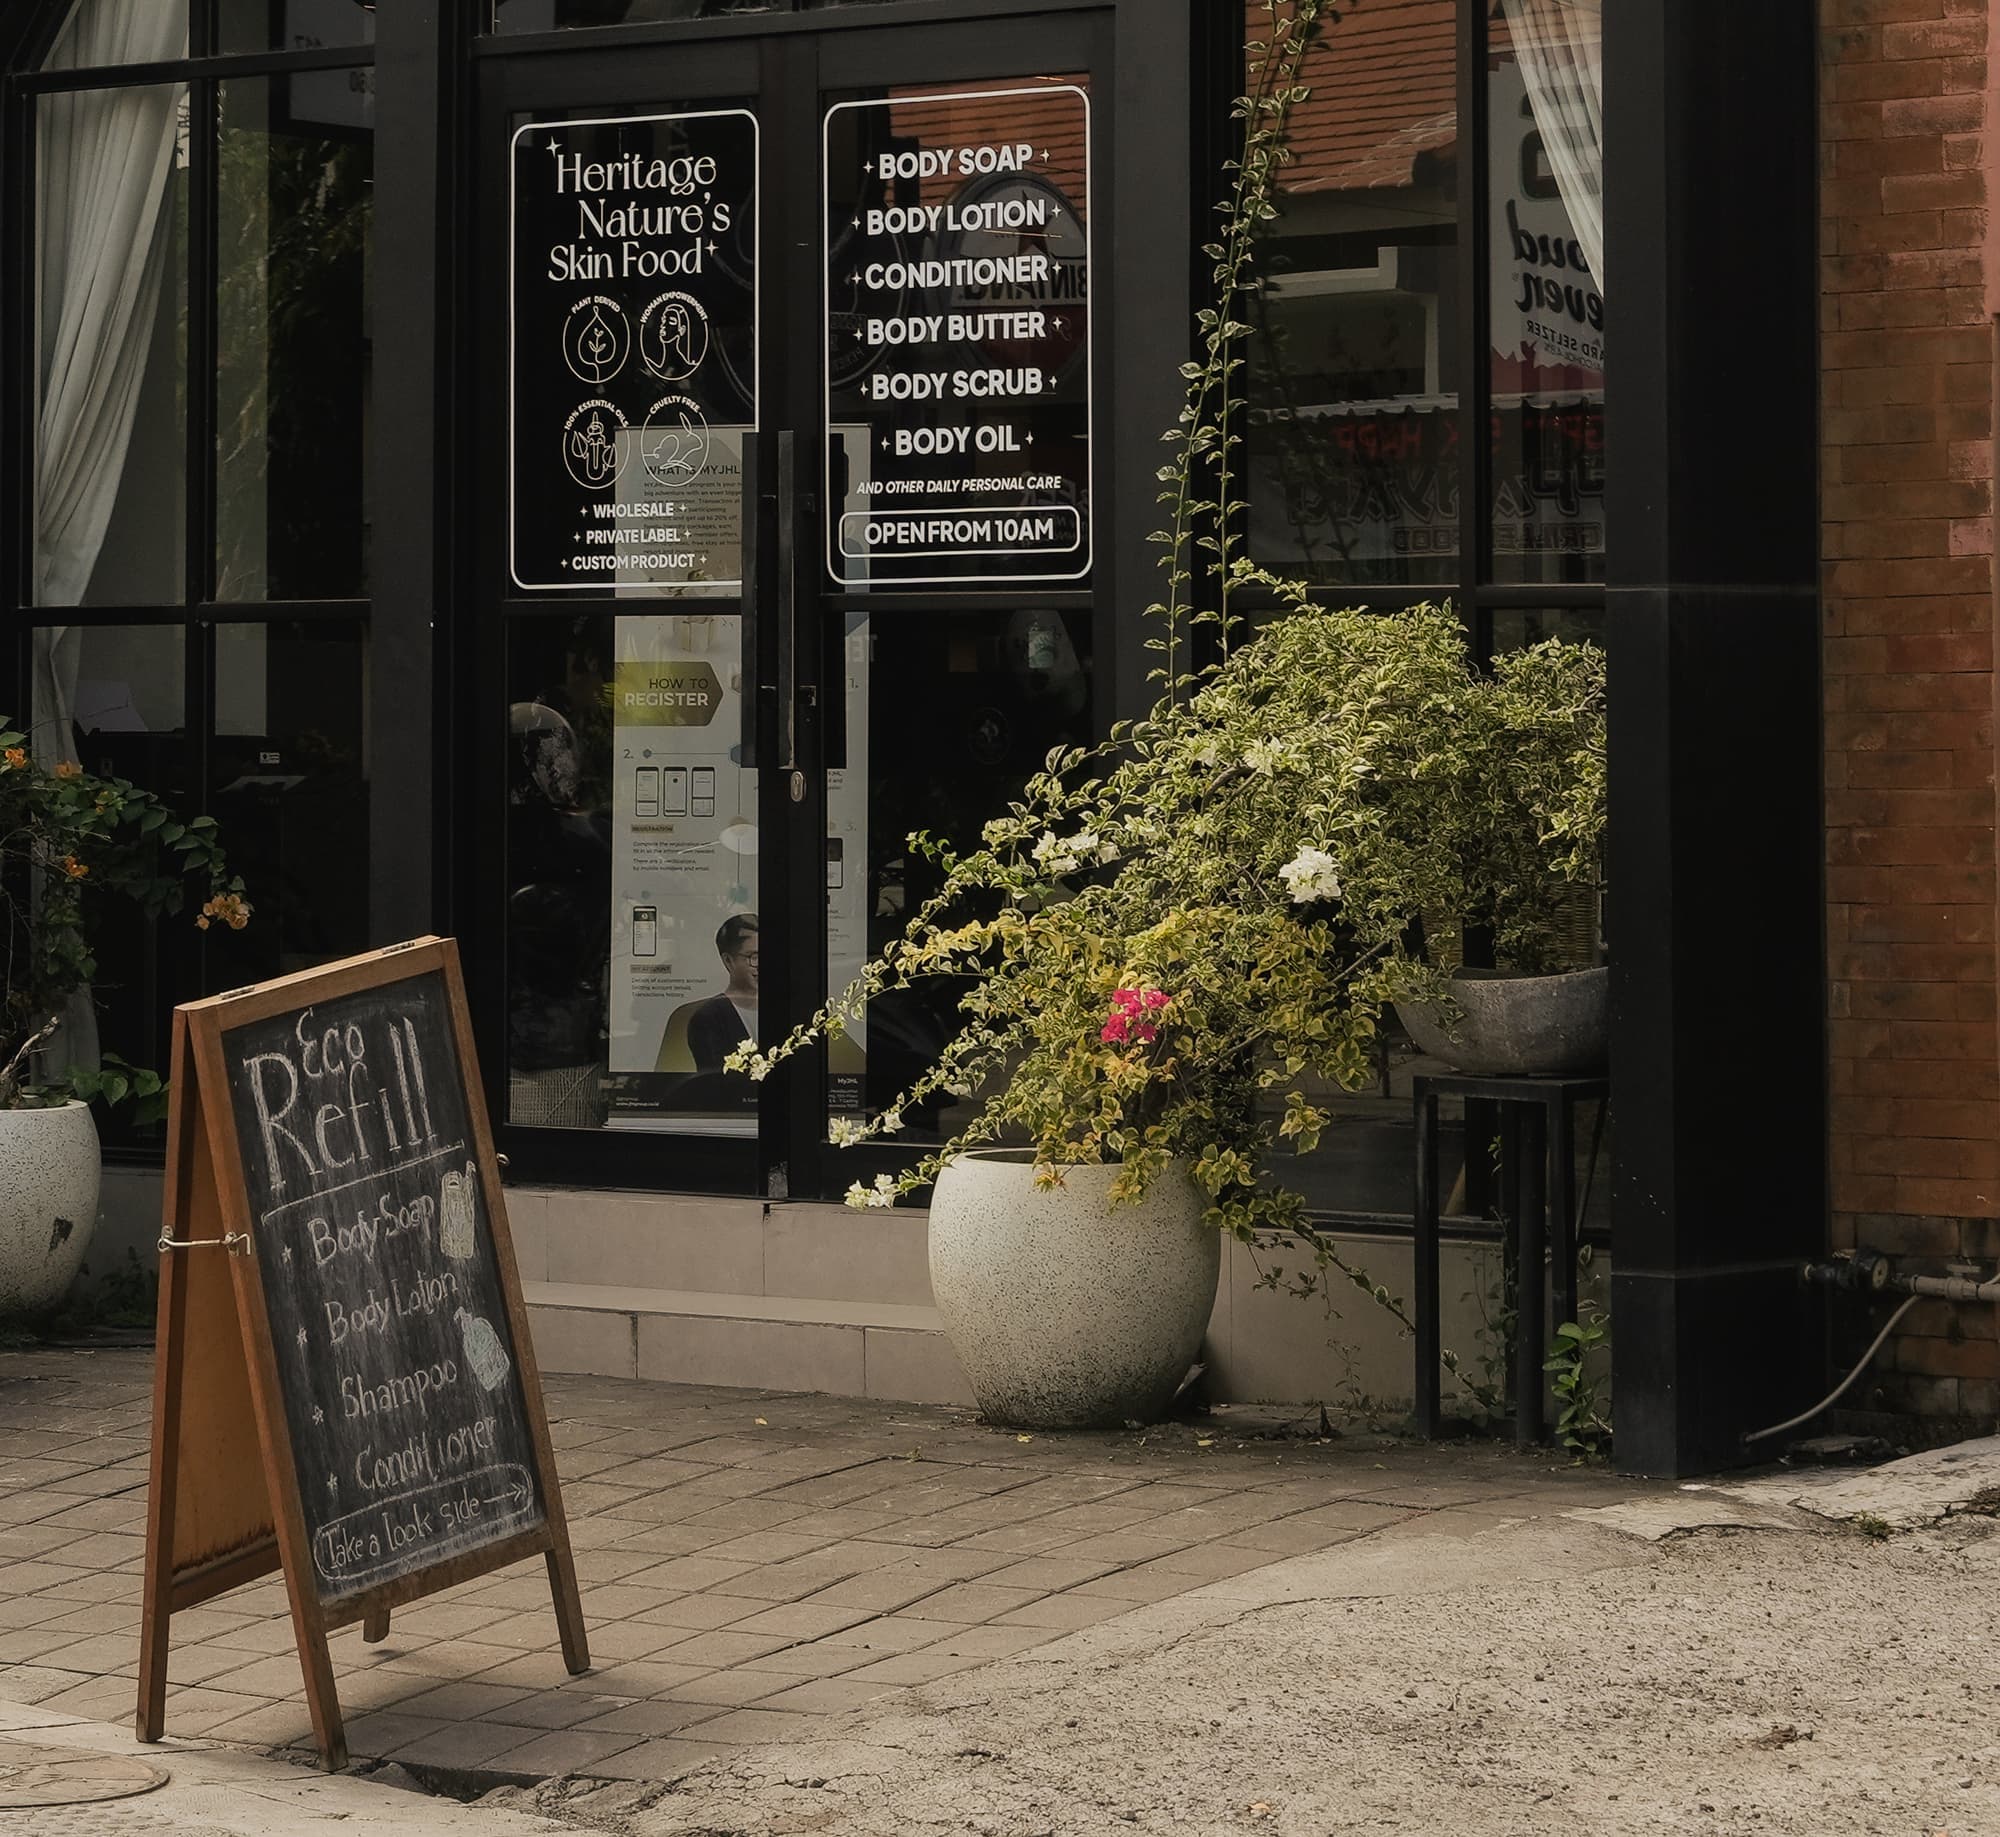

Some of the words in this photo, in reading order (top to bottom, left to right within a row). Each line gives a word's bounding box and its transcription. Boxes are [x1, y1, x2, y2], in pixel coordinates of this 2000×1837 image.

[557, 152, 716, 195] Heritage
[879, 149, 954, 179] BODY
[958, 144, 1033, 175] SOAP
[578, 192, 731, 239] Nature's
[867, 206, 942, 235] BODY
[947, 200, 1045, 231] LOTION
[548, 244, 613, 281] Skin
[622, 237, 702, 277] Food
[865, 255, 1048, 290] CONDITIONER
[571, 297, 591, 314] PLANT
[594, 295, 621, 312] DERIVED
[640, 296, 663, 323] WOMAN
[867, 316, 943, 345] BODY
[948, 311, 1046, 341] BUTTER
[872, 373, 948, 400] BODY
[952, 368, 1043, 398] SCRUB
[564, 410, 579, 430] 100%
[578, 399, 616, 413] ESSENTIAL
[615, 409, 629, 428] OILS
[649, 395, 681, 415] CRUELTY
[682, 396, 701, 413] FREE
[896, 426, 971, 456] BODY
[975, 425, 1020, 453] OIL
[645, 465, 680, 475] WHAT
[700, 465, 740, 474] MYJHL
[857, 481, 884, 494] AND
[885, 480, 924, 494] OTHER
[926, 479, 960, 493] DAILY
[961, 477, 1025, 492] PERSONAL
[1026, 476, 1062, 490] CARE
[593, 502, 674, 518] WHOLESALE
[586, 529, 639, 544] PRIVATE
[641, 528, 681, 543] LABEL
[864, 522, 925, 545] OPEN
[928, 520, 991, 543] FROM
[995, 518, 1054, 542] 10AM
[572, 555, 628, 571] CUSTOM
[630, 553, 695, 569] PRODUCT
[624, 692, 709, 707] REGISTER
[650, 679, 684, 689] HOW
[689, 679, 708, 689] TO
[624, 749, 634, 759] 2.
[296, 1008, 366, 1077] Eco
[243, 1016, 438, 1192] Refill
[307, 1210, 381, 1267] Body
[379, 1191, 435, 1242] Soap
[324, 1288, 391, 1345] Body
[391, 1271, 459, 1317] Lotion
[341, 1358, 458, 1420] Shampoo
[322, 1524, 364, 1570] Take
[368, 1532, 381, 1556] a
[382, 1503, 433, 1552] look
[439, 1487, 481, 1530] side
